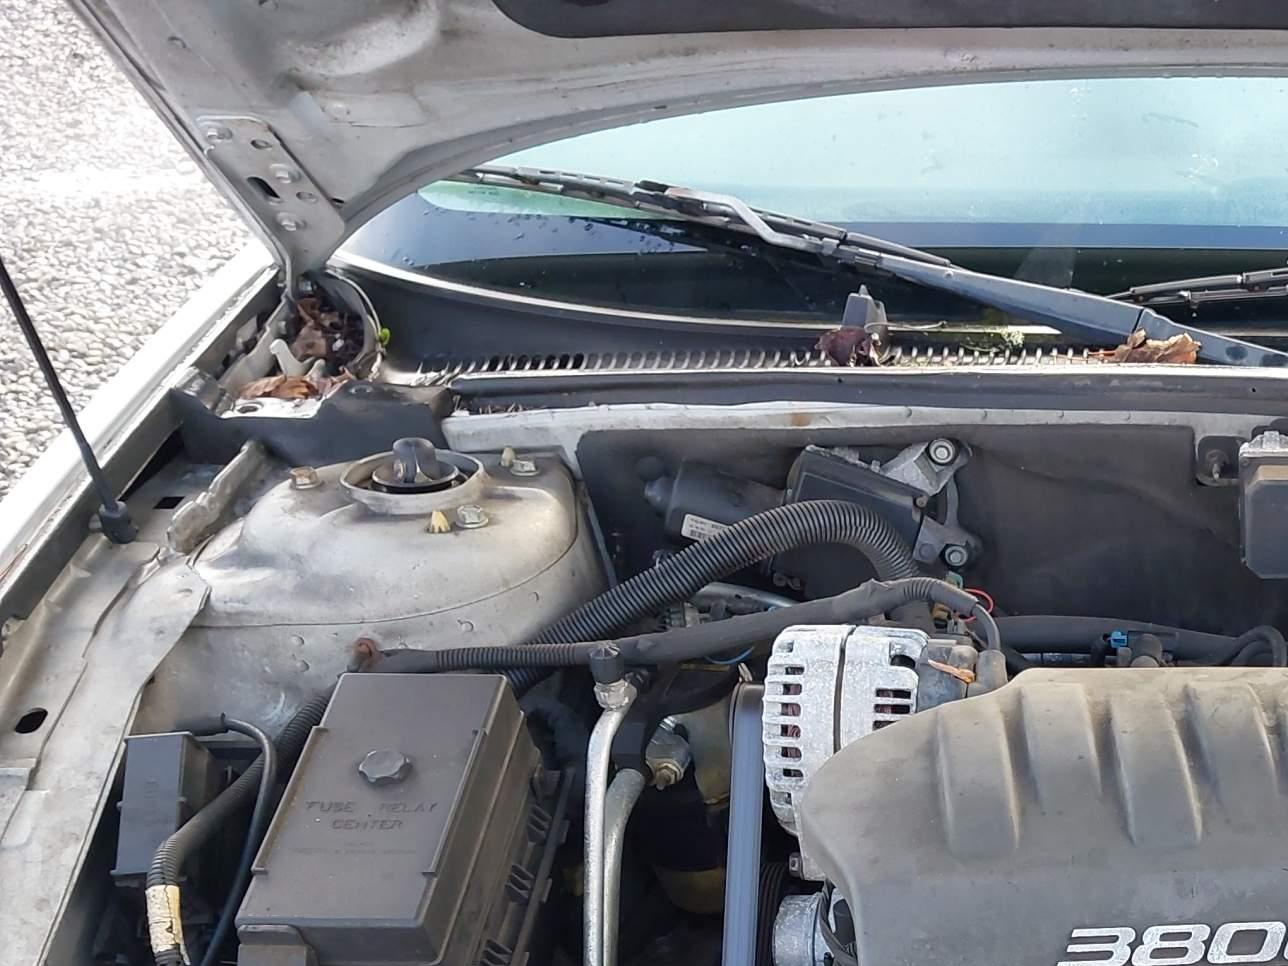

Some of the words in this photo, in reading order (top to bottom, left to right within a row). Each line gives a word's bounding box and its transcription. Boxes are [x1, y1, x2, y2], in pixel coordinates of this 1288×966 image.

[305, 801, 357, 813] FUSE
[380, 802, 438, 813] RELAY
[332, 819, 403, 831] CENTER
